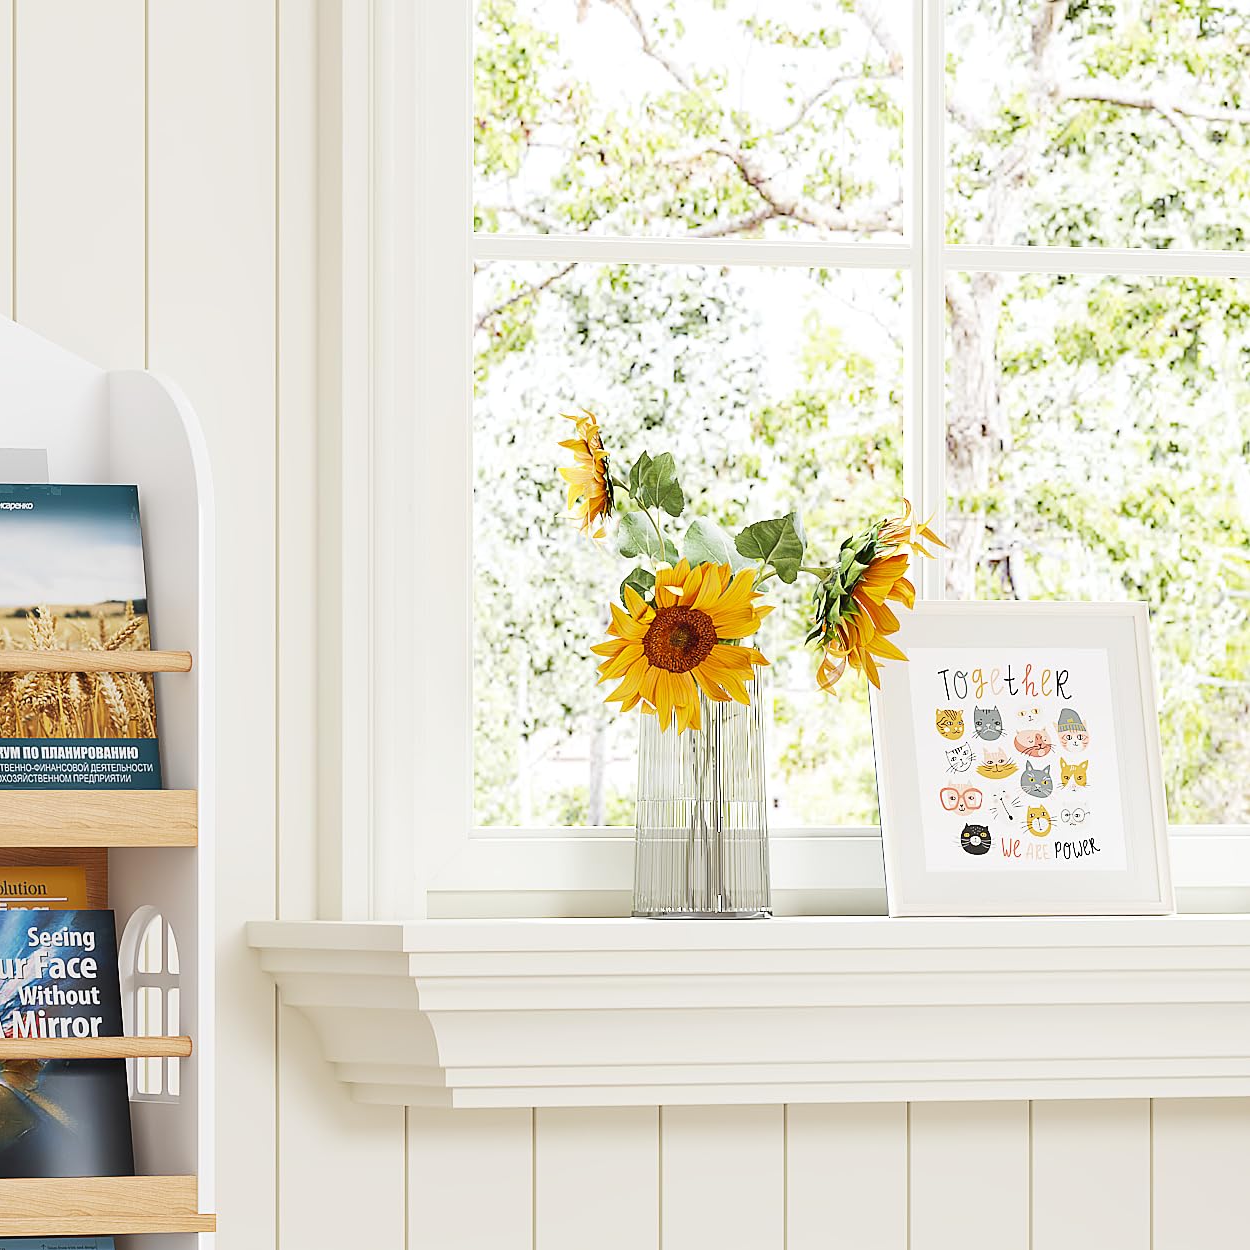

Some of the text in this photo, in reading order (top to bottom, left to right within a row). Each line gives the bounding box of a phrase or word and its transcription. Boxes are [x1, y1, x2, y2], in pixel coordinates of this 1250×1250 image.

[22, 746, 39, 760] ПО
[41, 746, 139, 760] ПЛАНИРОВАНИЮ
[73, 773, 132, 784] ПРЕДПРИЯТИИ
[90, 762, 154, 774] ДЕЯТЕЛЬНОСТИ
[28, 927, 96, 951] Seeing
[35, 951, 98, 980] Face
[18, 985, 100, 1006] Without
[12, 1010, 103, 1038] Mirror
